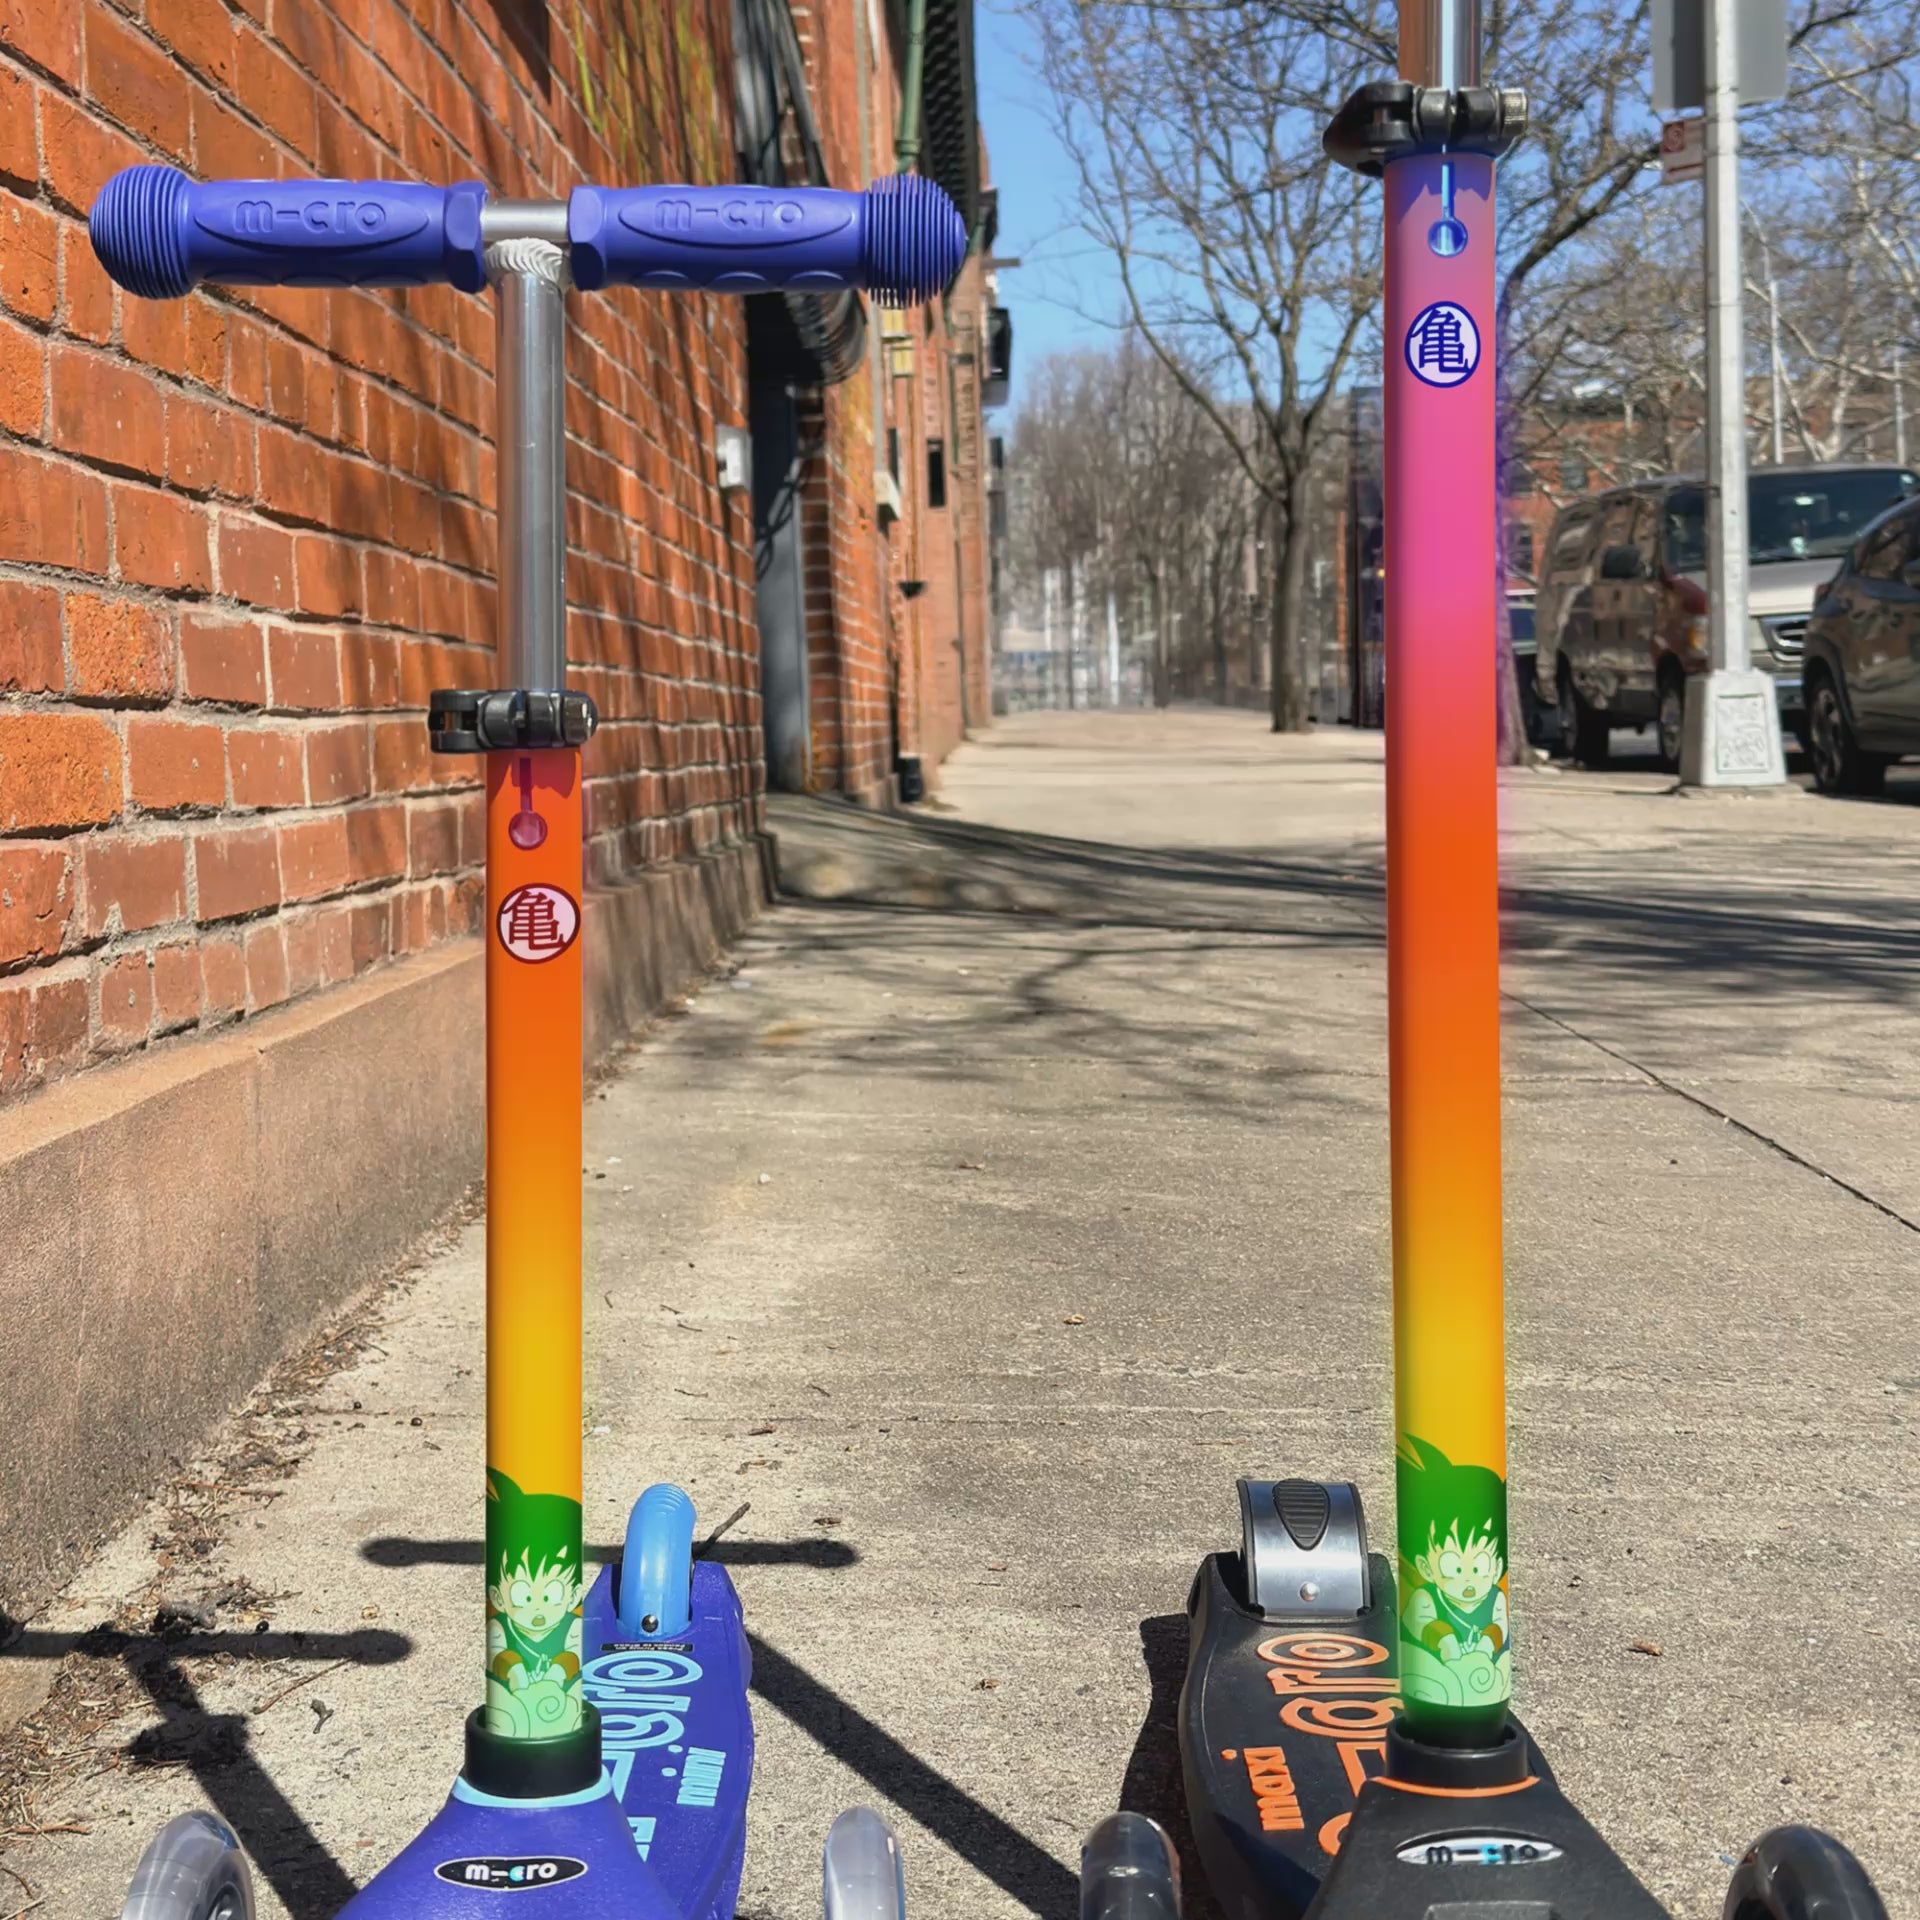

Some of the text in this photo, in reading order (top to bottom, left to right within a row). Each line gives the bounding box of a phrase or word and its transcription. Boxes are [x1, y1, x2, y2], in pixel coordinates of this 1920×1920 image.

[234, 200, 386, 235] m-cro
[654, 200, 805, 232] m-cro
[661, 1744, 726, 1807] mini
[1221, 1746, 1304, 1831] maxi
[465, 1860, 558, 1883] m-cro
